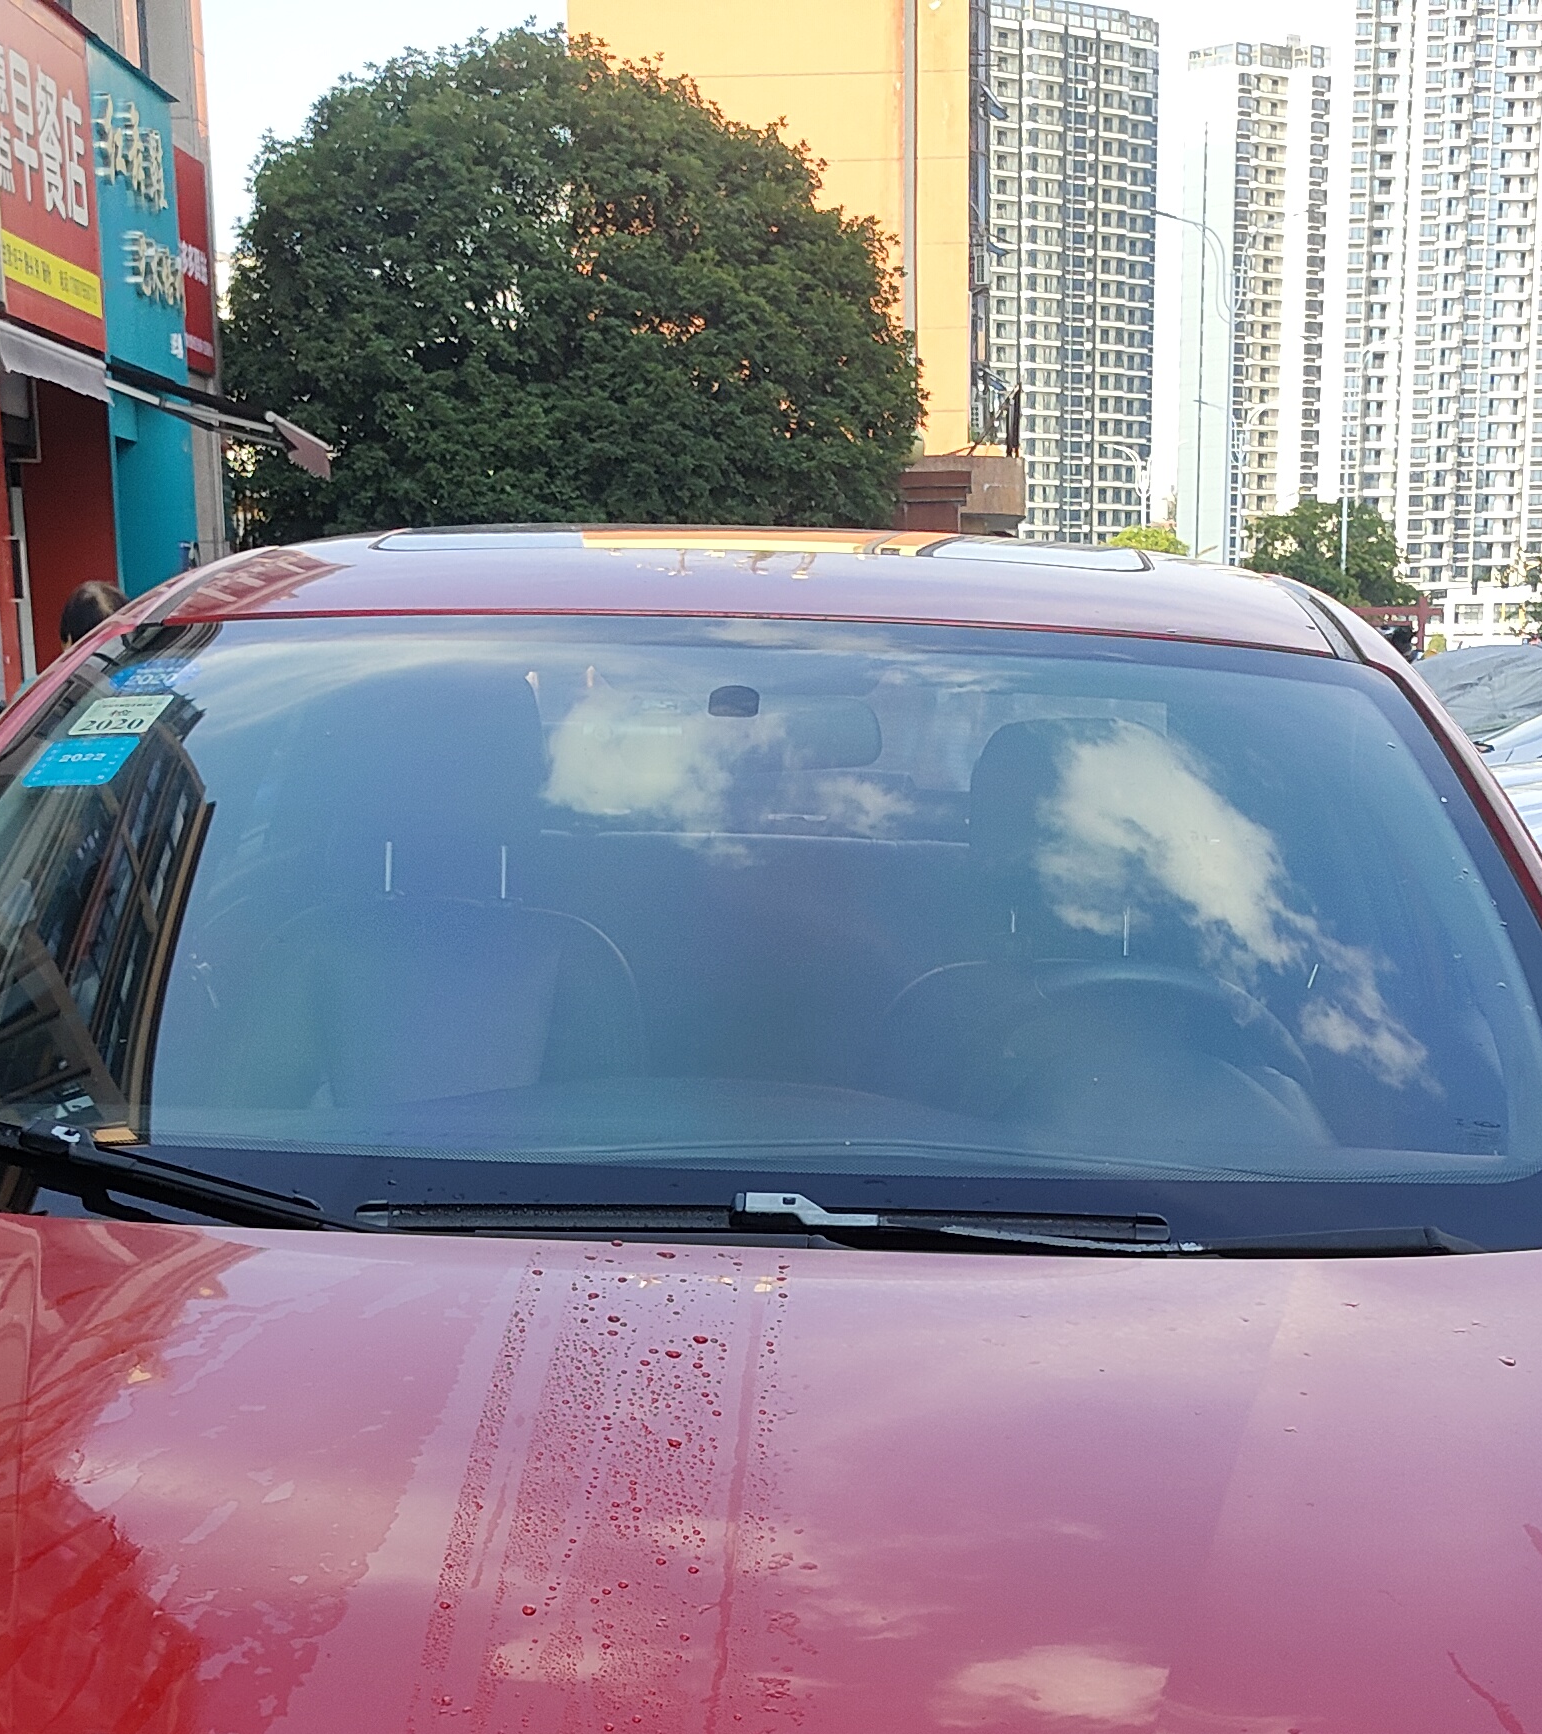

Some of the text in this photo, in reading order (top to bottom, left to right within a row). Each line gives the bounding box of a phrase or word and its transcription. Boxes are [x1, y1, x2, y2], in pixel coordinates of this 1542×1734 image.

[9, 48, 89, 228] 早餐店
[78, 717, 145, 732] 2020
[59, 753, 107, 763] 2022
